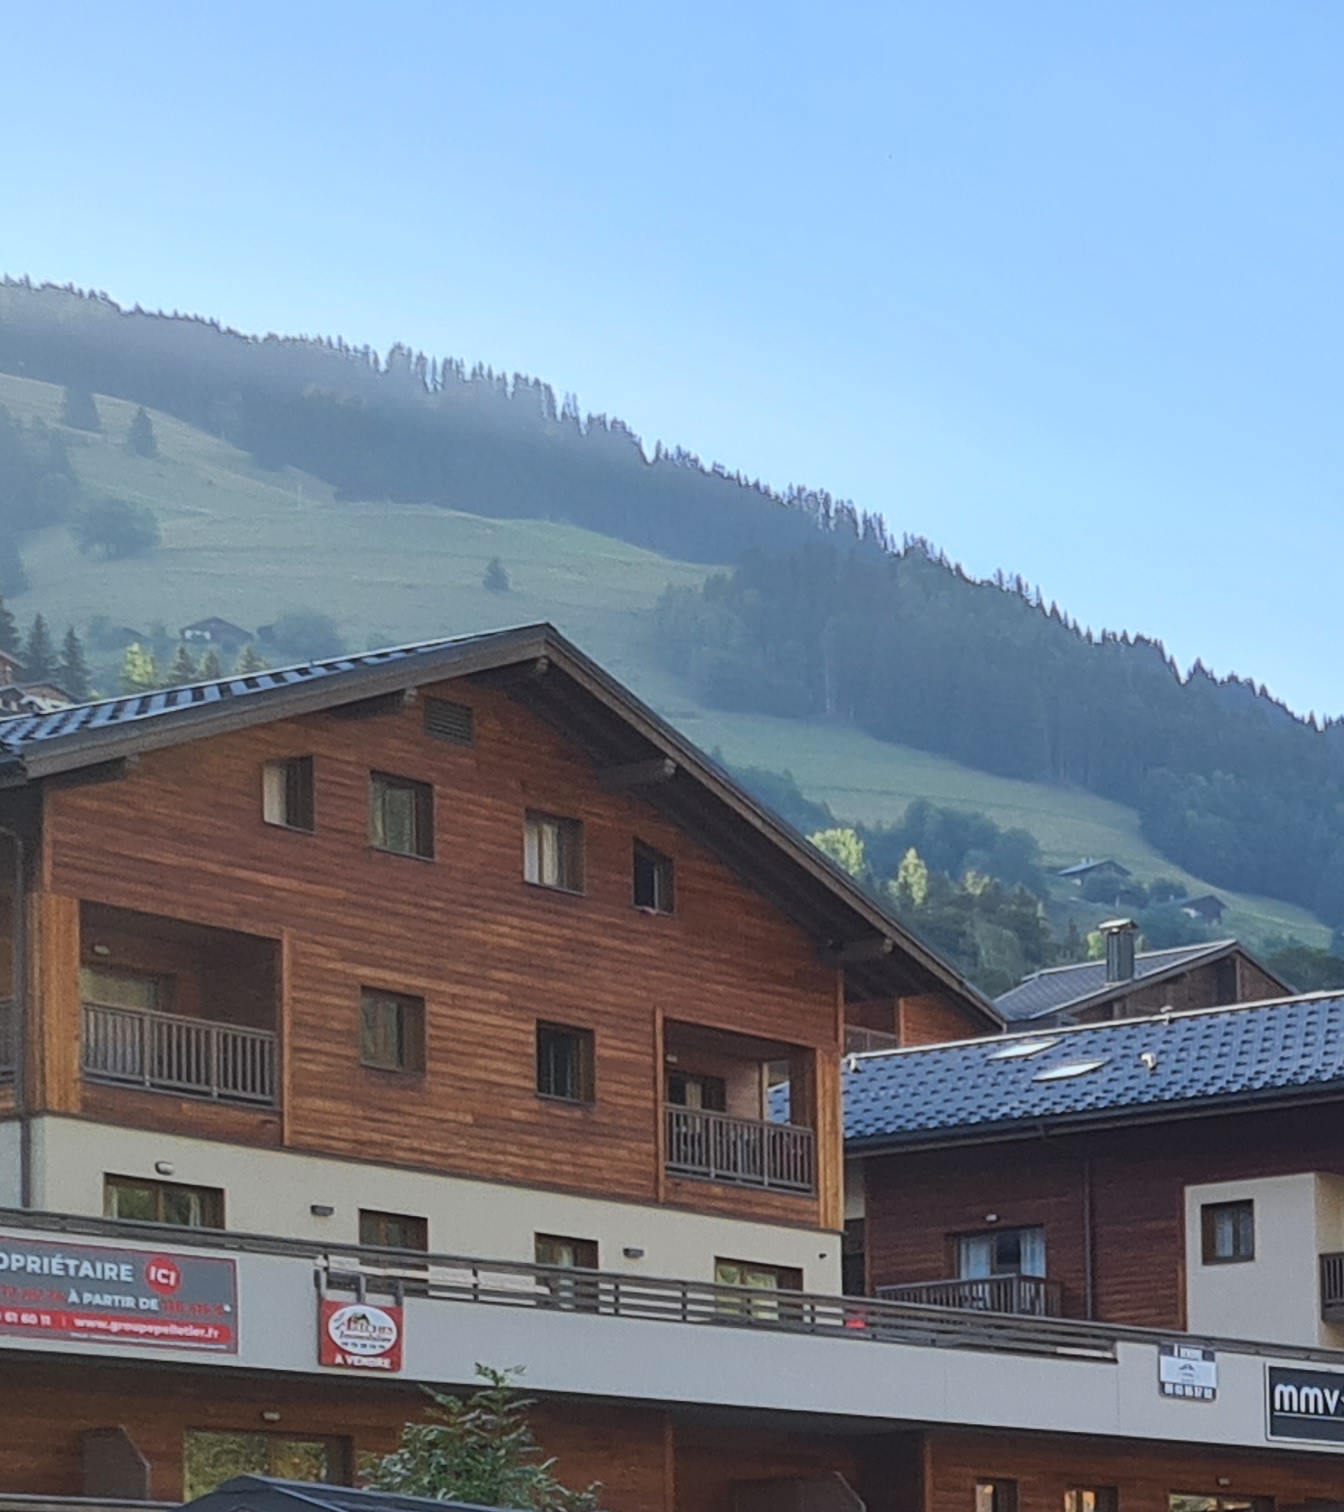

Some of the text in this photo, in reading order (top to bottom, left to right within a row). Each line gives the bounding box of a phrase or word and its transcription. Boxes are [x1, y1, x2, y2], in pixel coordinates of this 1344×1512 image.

[150, 1265, 176, 1287] ICI
[82, 1292, 136, 1309] PARTIR
[138, 1297, 160, 1312] DE
[1274, 1383, 1340, 1415] mmv
